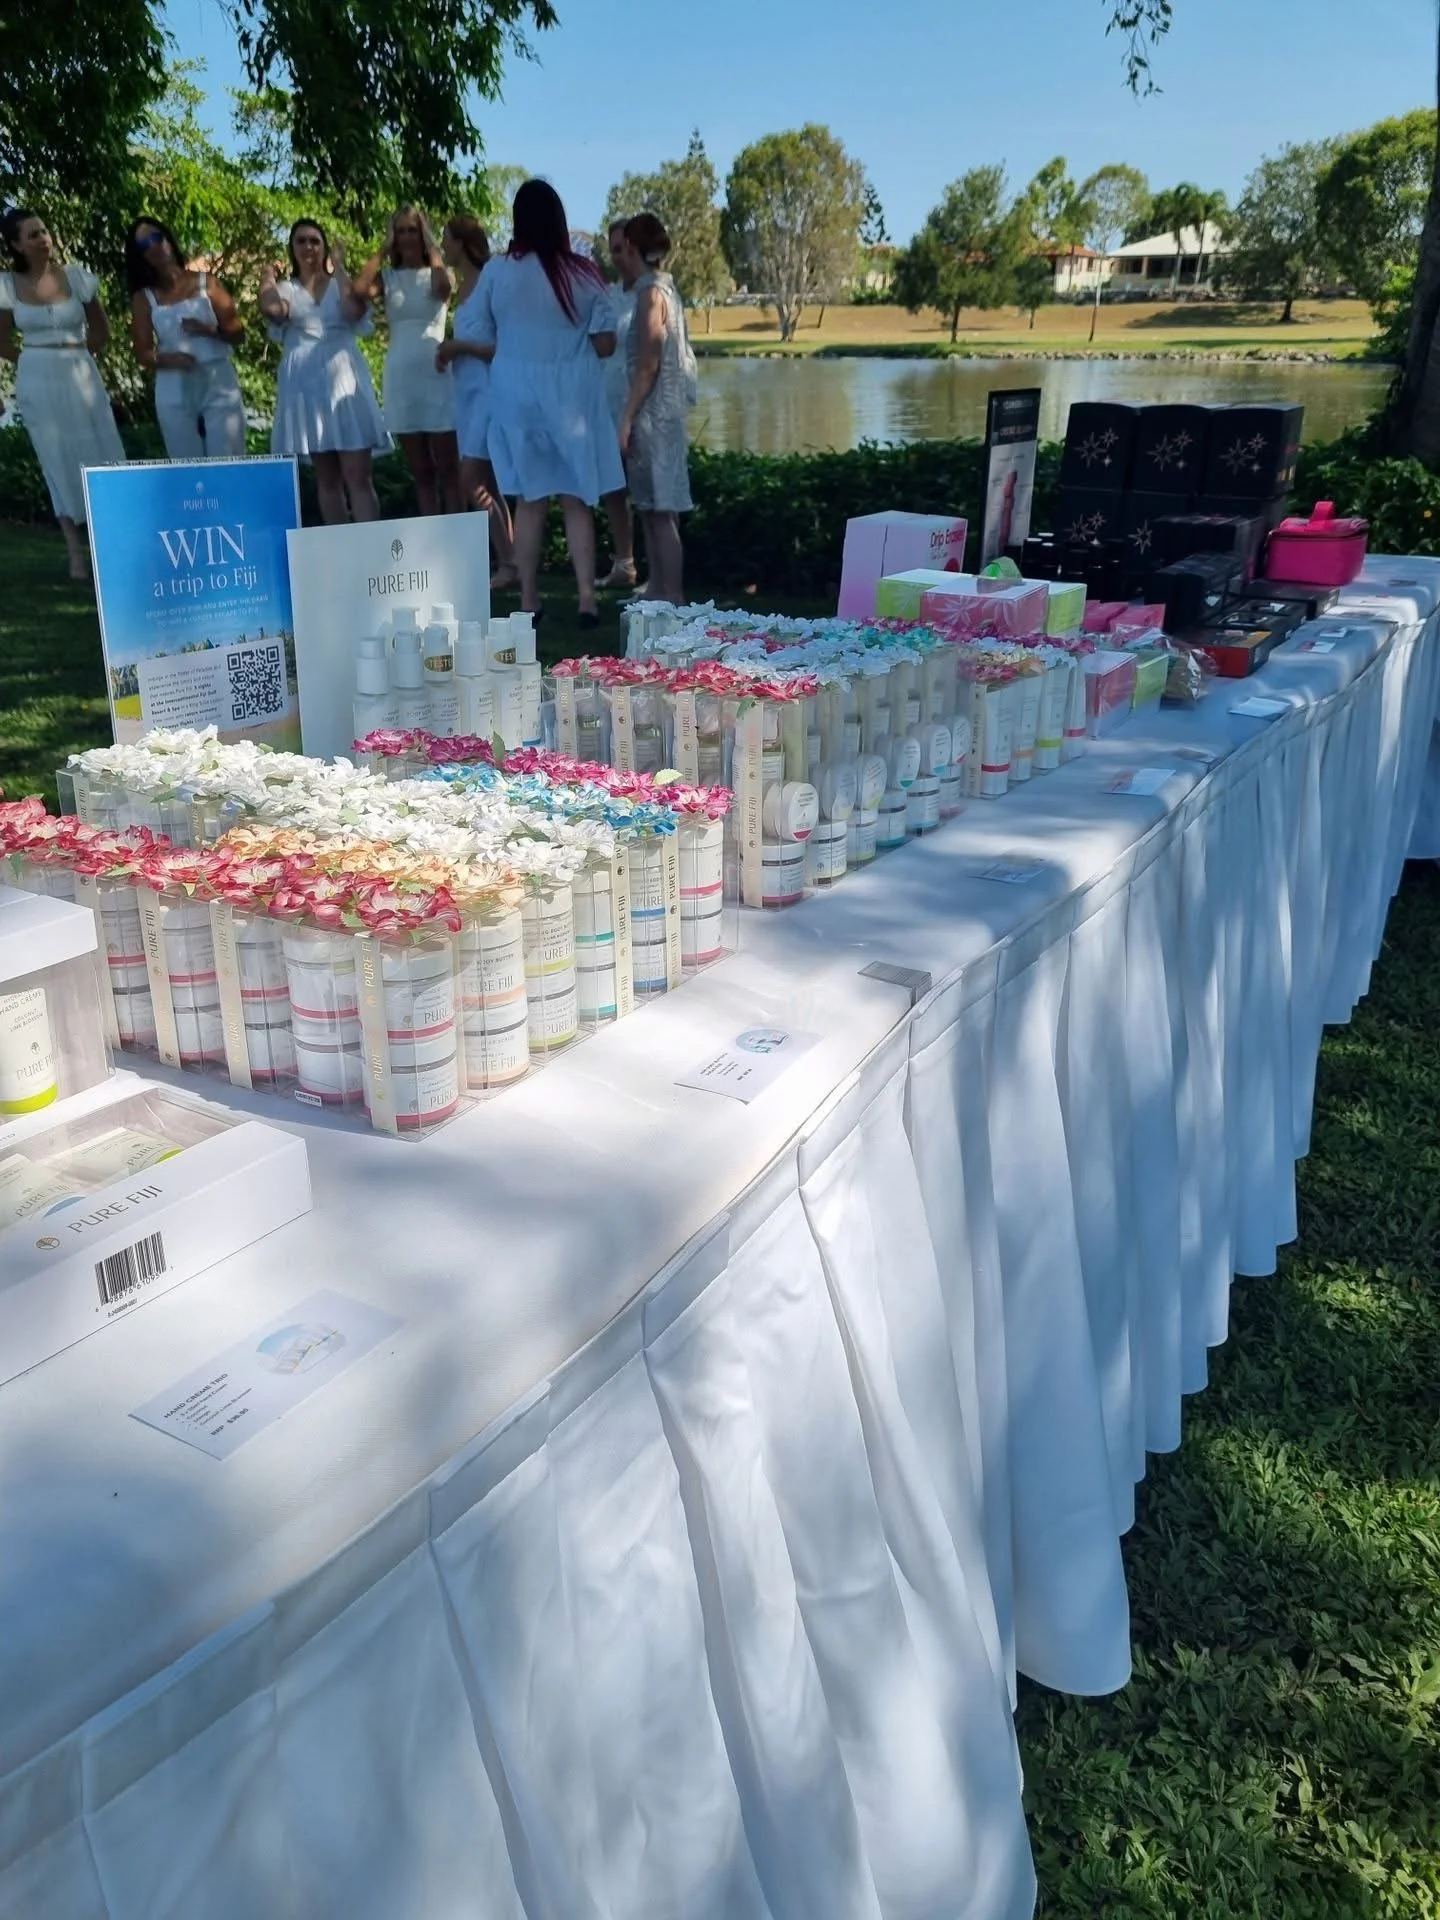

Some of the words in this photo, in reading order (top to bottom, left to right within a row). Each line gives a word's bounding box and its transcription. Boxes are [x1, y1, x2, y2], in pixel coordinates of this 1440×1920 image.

[183, 499, 203, 511] PURE
[158, 524, 244, 569] WIN
[154, 580, 164, 597] a
[171, 573, 204, 597] trip
[210, 571, 228, 589] to
[233, 565, 258, 590] Fiji
[368, 573, 405, 597] PURE
[408, 569, 428, 592] FIJI
[748, 796, 757, 813] FIJI
[748, 812, 757, 835] PURE
[668, 872, 676, 900] PURE
[617, 895, 625, 911] FIJI
[144, 908, 156, 927] FIJI
[215, 908, 226, 927] FIJI
[617, 913, 626, 940] PURE
[146, 930, 159, 959] PURE
[364, 956, 374, 987] PURE
[498, 975, 513, 990] FIJI
[16, 1061, 46, 1080] PURE
[15, 1192, 46, 1217] PURE
[67, 1201, 130, 1233] PURE
[125, 1185, 163, 1204] FIJI
[164, 1402, 186, 1418] HAND
[185, 1384, 212, 1403] CREME
[210, 1373, 229, 1385] TRIO
